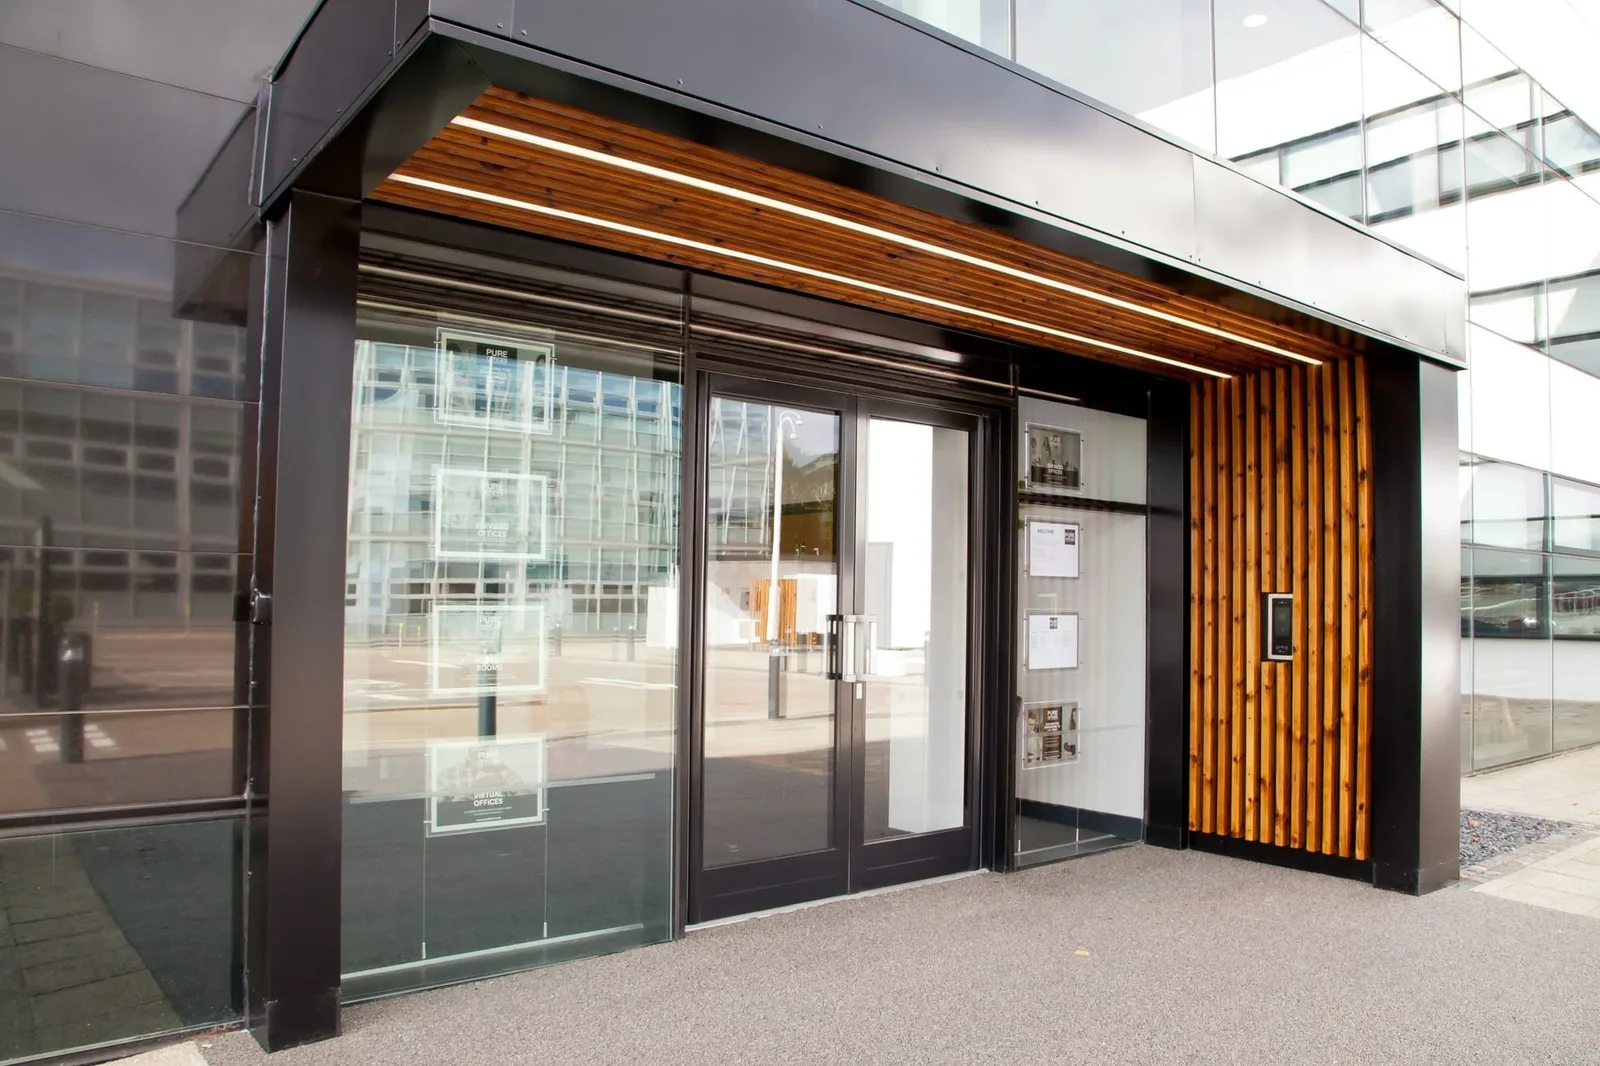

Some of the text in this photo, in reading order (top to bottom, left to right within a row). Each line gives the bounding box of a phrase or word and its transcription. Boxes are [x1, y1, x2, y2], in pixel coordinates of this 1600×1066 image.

[486, 348, 508, 358] PURE
[473, 791, 504, 800] VIRTUAL
[473, 797, 504, 807] OFFICES
